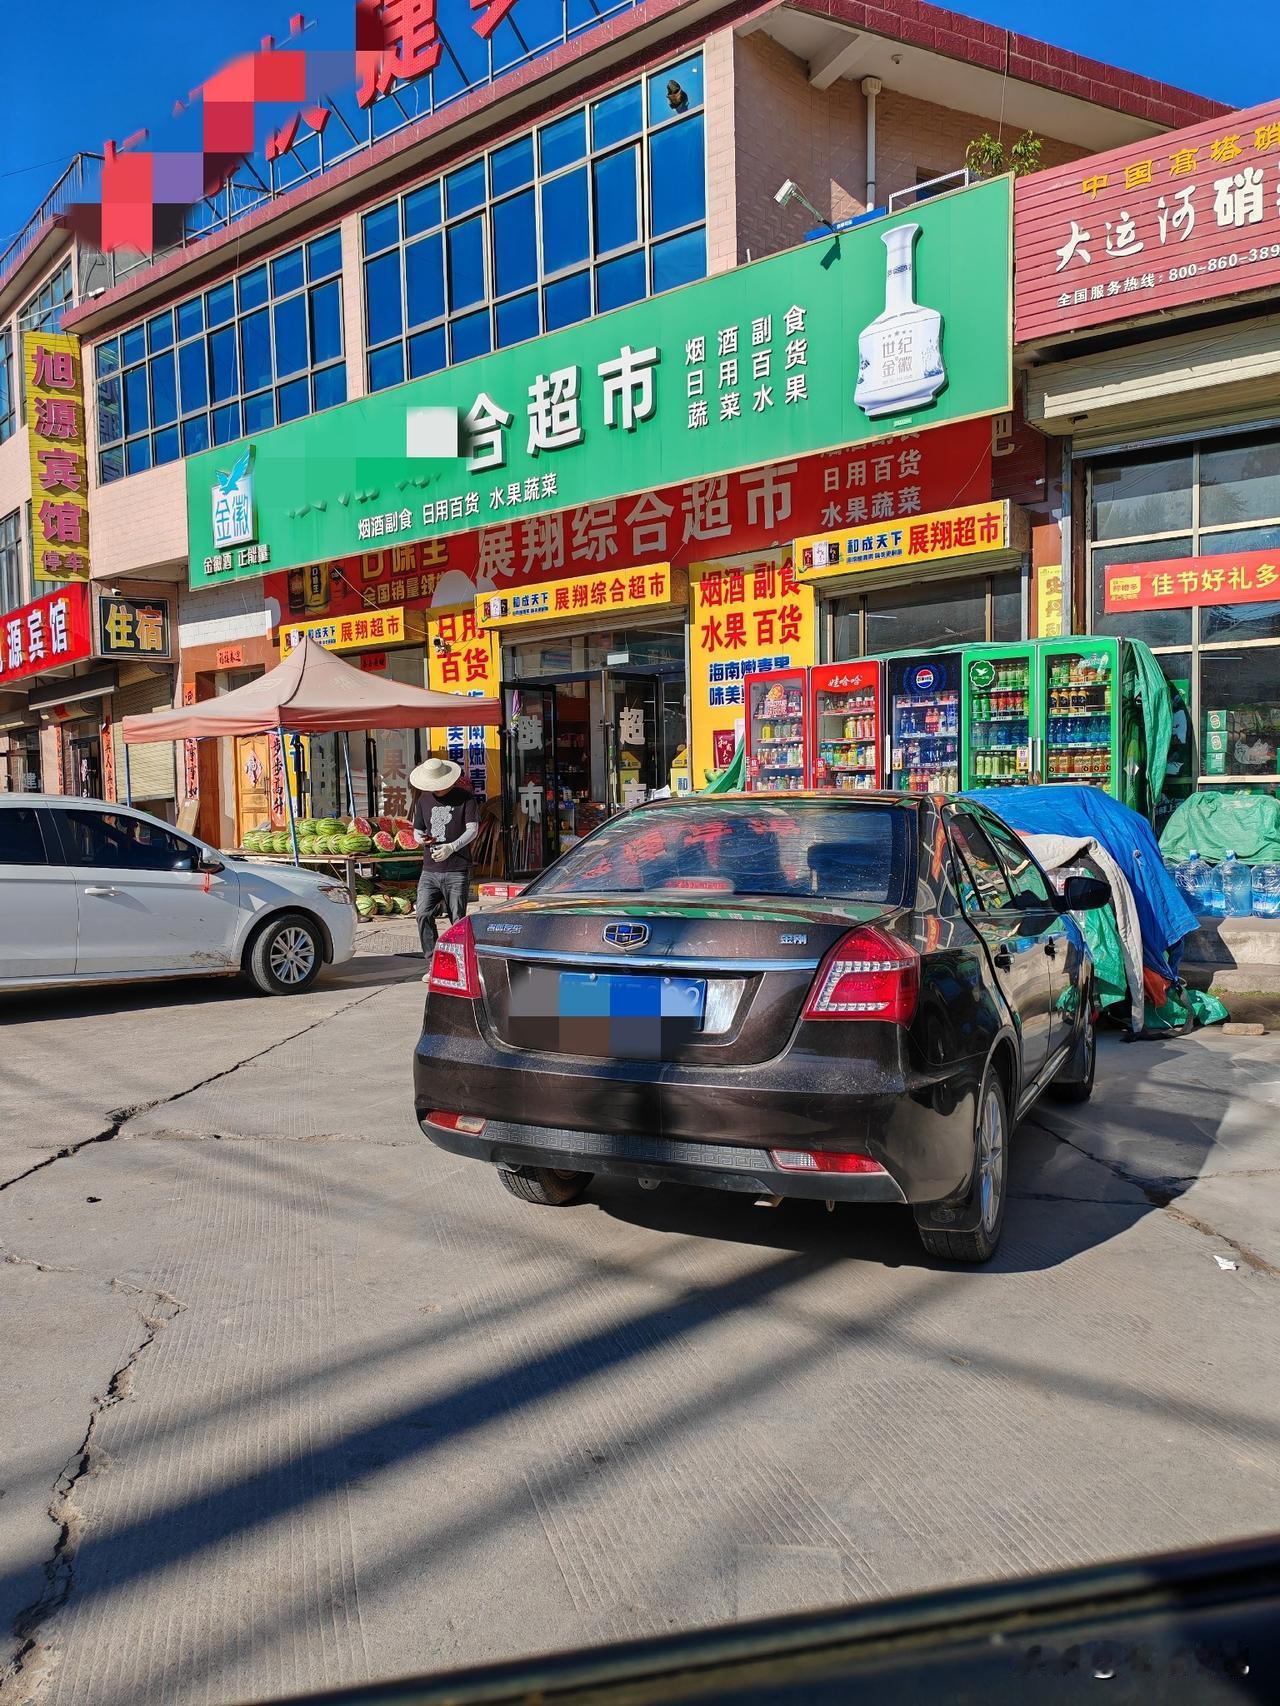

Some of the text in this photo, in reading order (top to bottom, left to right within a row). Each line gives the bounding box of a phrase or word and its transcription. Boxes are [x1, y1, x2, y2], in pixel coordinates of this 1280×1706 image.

[685, 304, 808, 366] 烟酒副食
[686, 339, 808, 397] 日用百货
[687, 373, 808, 430] 蔬菜水果
[32, 345, 82, 544] 旭源宾馆
[823, 449, 922, 493] 日用百货
[358, 472, 558, 541] 烟酒副食 日用百货 水果蔬菜
[475, 462, 798, 579] 展翔综合超市
[820, 485, 922, 528] 水果蔬菜
[847, 512, 1001, 556] 和成天下 展翔超市
[40, 550, 84, 573] 停车
[555, 571, 666, 611] 展翔综合超市
[701, 564, 745, 608] 烟酒
[0, 598, 68, 672] 源宾馆
[105, 604, 163, 652] 住宿
[340, 615, 400, 642] 展翔超市
[701, 604, 803, 653] 水果 百货
[436, 646, 489, 684] 百货
[709, 685, 744, 706] 味美
